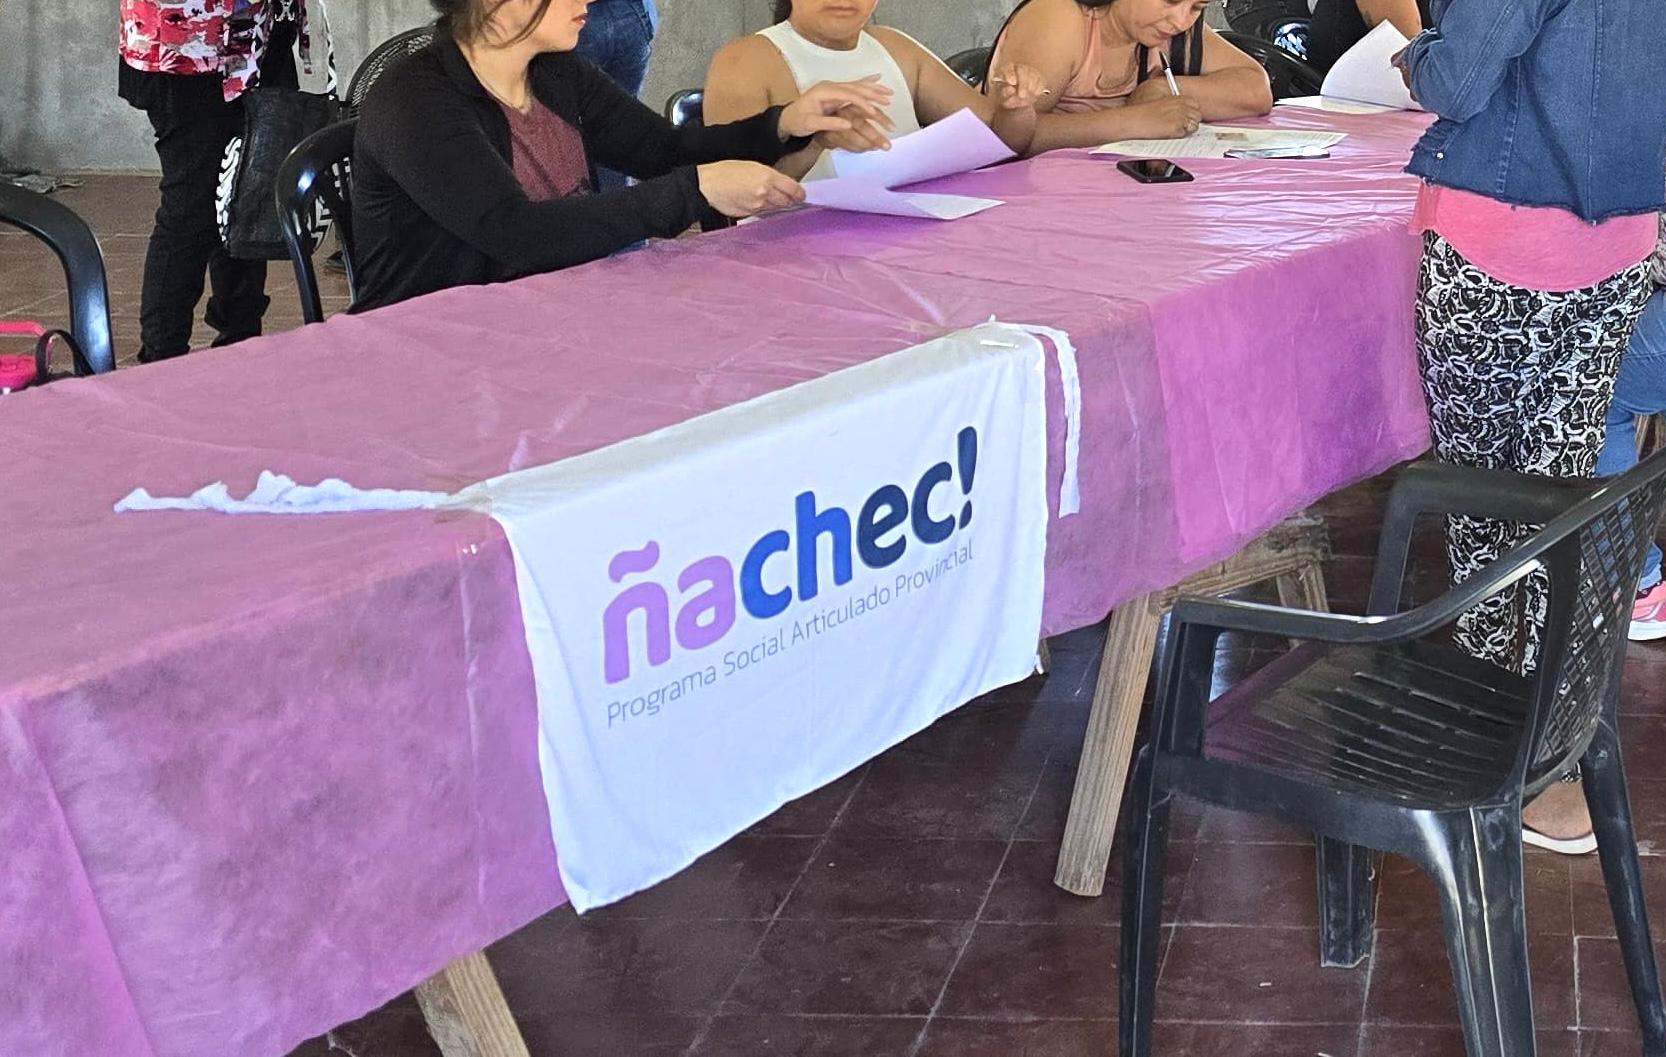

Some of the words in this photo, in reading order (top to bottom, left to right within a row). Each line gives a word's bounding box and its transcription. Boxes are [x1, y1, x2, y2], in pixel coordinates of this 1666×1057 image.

[603, 426, 978, 685] ñachec!
[607, 664, 716, 729] Programa
[723, 627, 785, 677] Social
[791, 585, 890, 646] Articulado
[895, 537, 973, 598] Provincial
